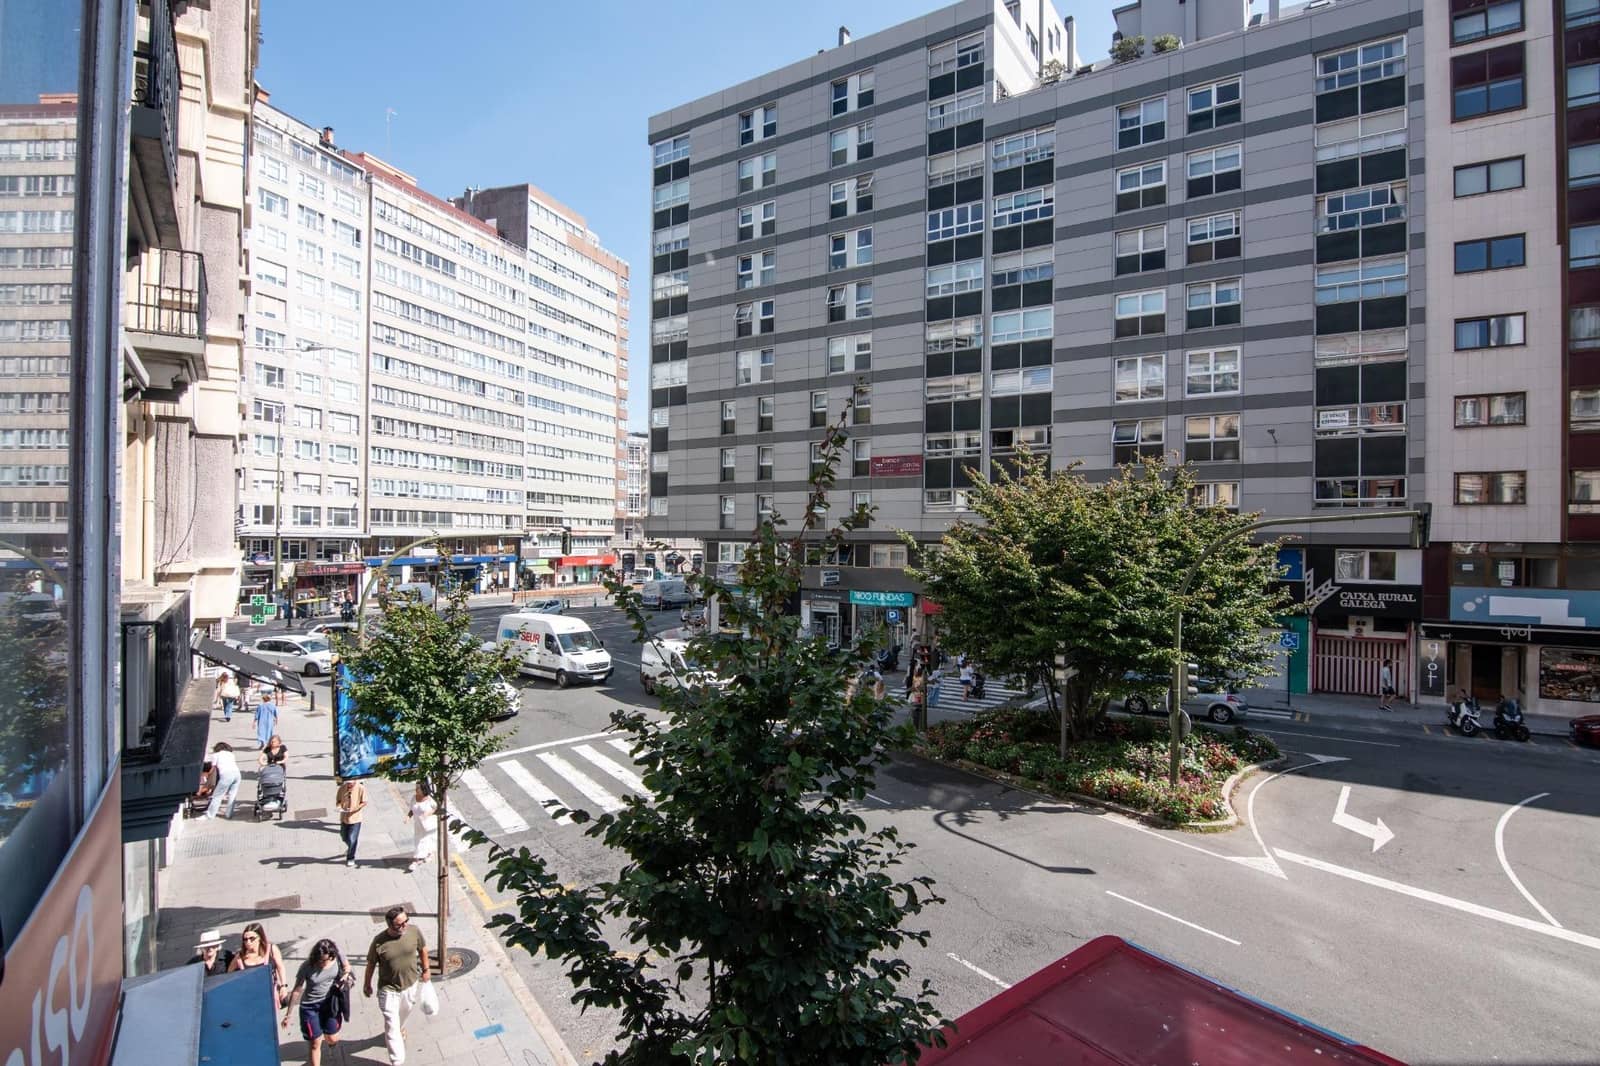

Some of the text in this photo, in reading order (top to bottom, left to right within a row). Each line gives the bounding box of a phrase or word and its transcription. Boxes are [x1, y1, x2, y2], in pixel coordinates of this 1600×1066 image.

[873, 592, 905, 602] FUNDAS
[1340, 592, 1416, 602] CAIXA RURAL
[1340, 600, 1386, 609] GALEGA
[521, 631, 540, 644] SEUR
